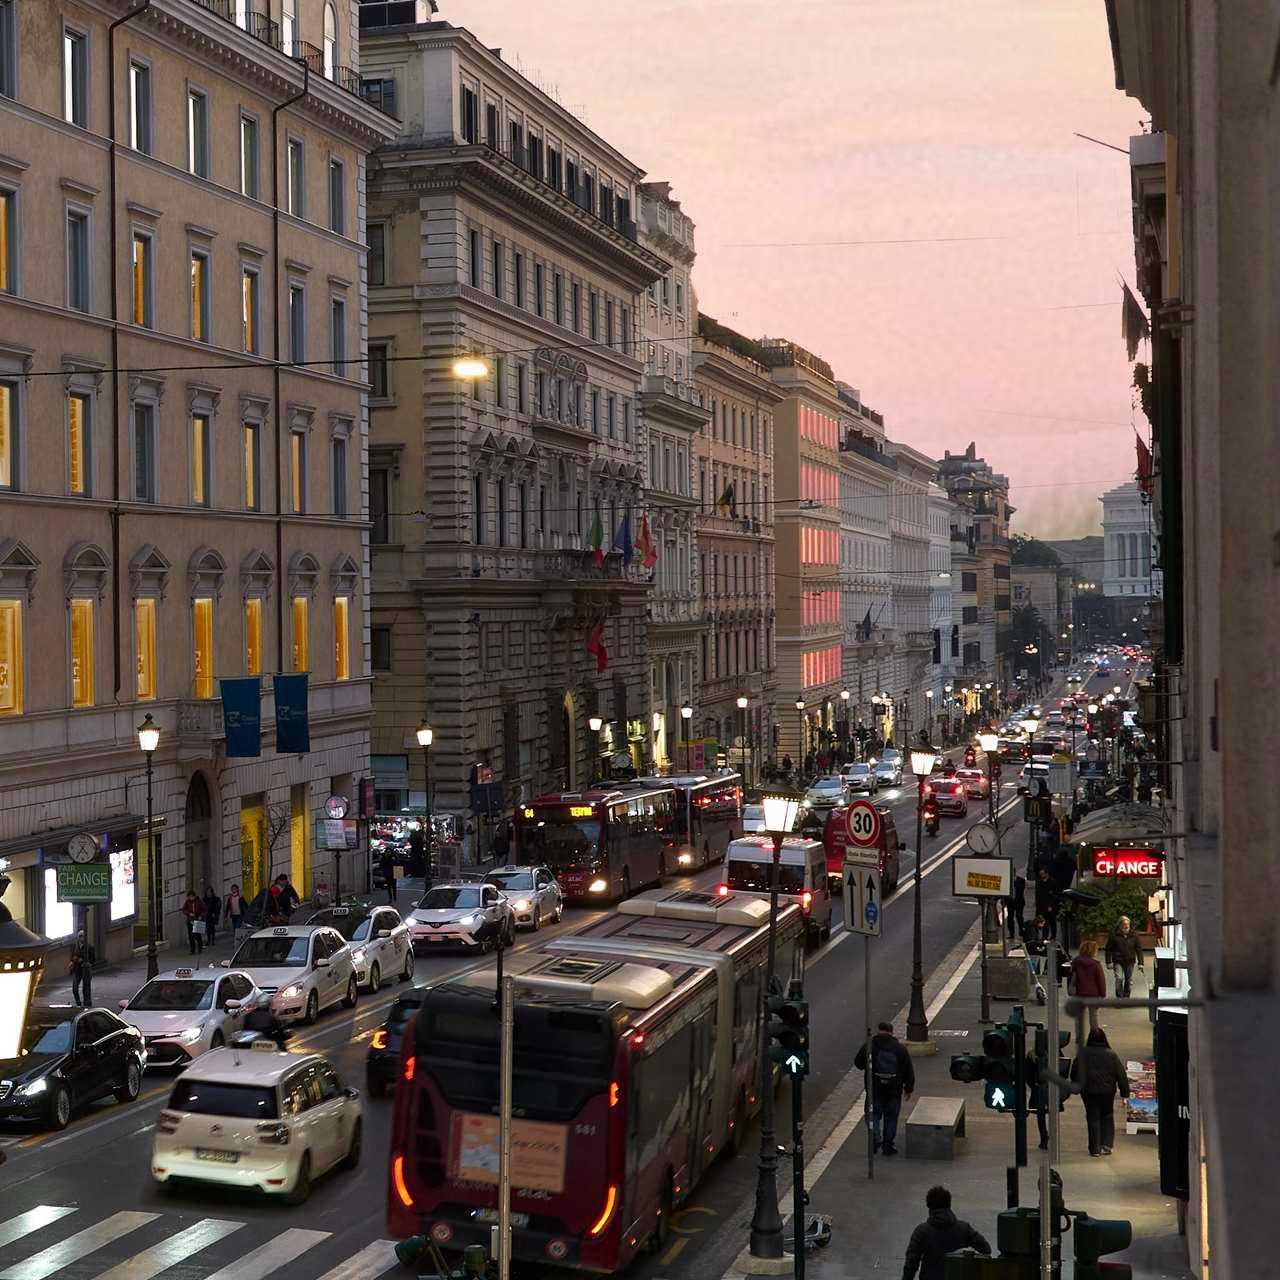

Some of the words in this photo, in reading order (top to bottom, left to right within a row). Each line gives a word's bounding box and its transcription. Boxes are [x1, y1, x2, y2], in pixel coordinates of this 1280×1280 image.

[524, 808, 534, 818] 64
[853, 812, 872, 834] 30
[1096, 861, 1158, 874] CHANGE
[58, 872, 108, 886] CHANGE
